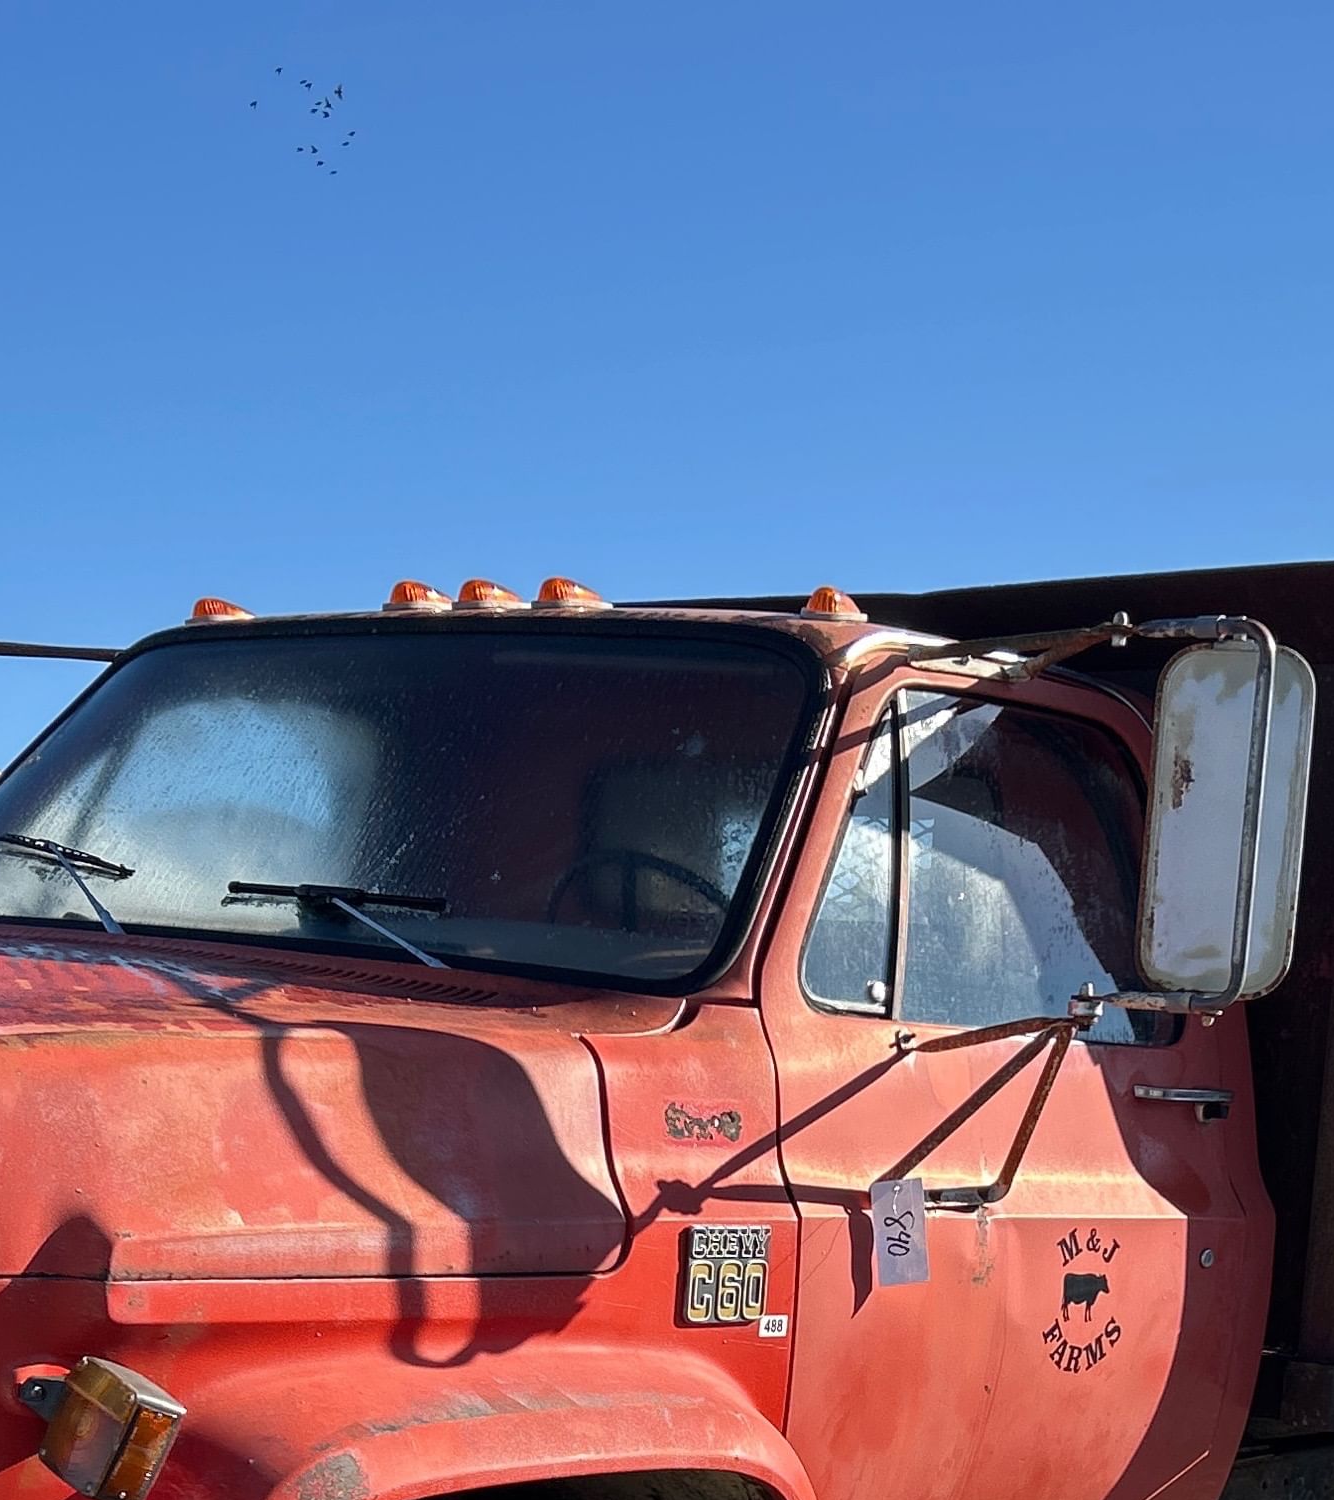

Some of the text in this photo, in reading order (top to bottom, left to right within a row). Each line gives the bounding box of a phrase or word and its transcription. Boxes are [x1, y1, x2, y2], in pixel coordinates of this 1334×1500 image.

[691, 1226, 771, 1258] CHEVY
[883, 1210, 915, 1257] 840
[687, 1259, 769, 1323] C60
[1042, 1316, 1122, 1374] FARMS
